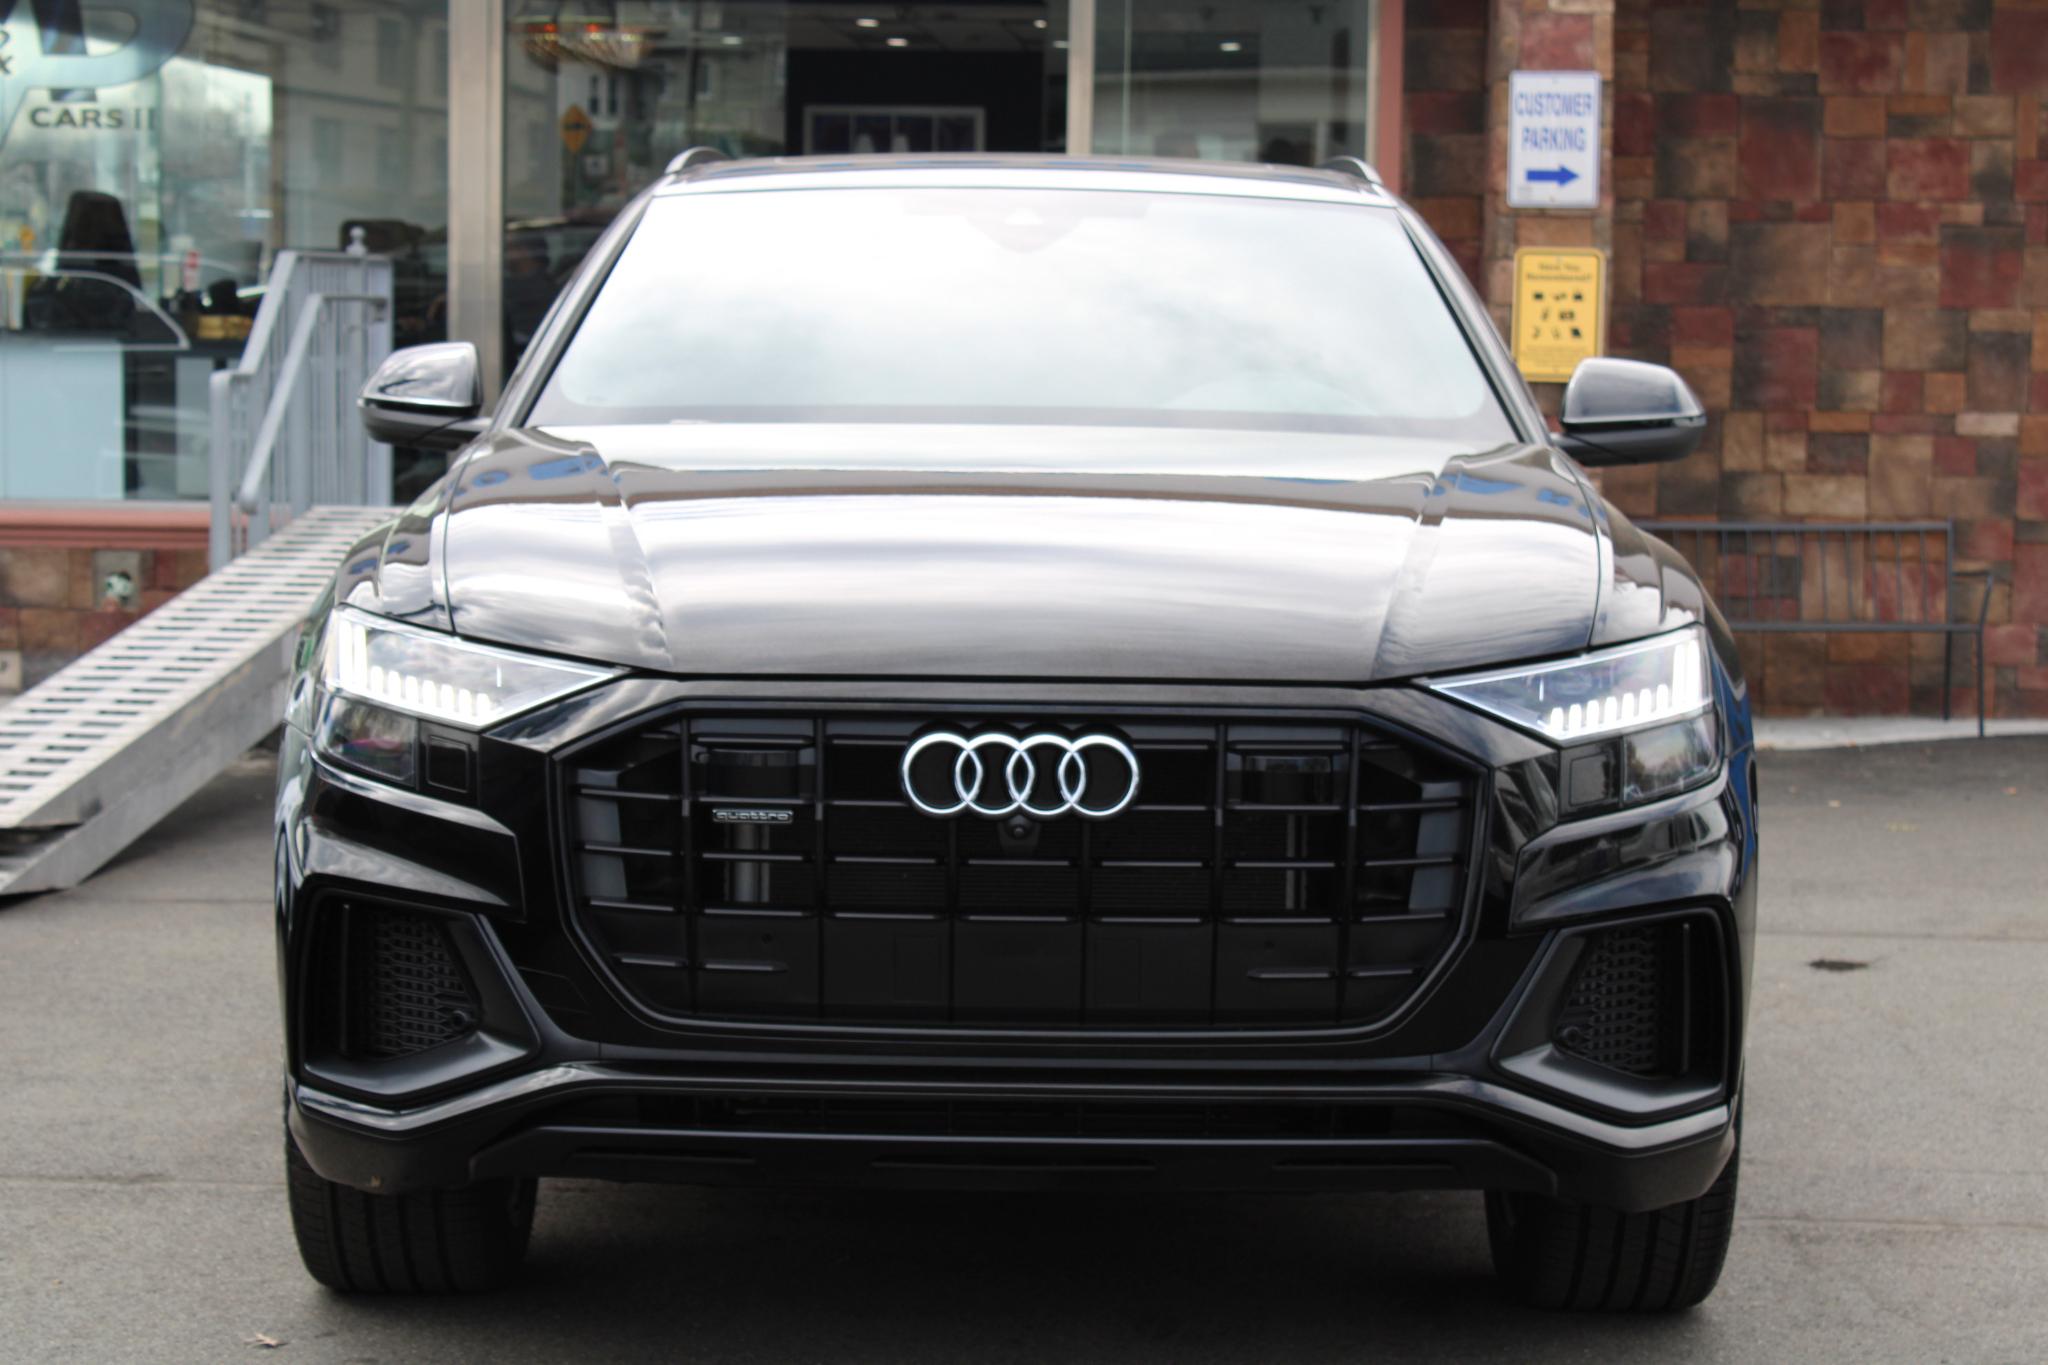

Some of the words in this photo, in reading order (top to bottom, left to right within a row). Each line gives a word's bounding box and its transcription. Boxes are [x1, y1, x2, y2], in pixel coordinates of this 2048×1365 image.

[1514, 92, 1592, 117] CUSTOMER
[30, 107, 123, 129] CARS
[1522, 126, 1587, 151] PARKING
[715, 810, 790, 821] quattro
